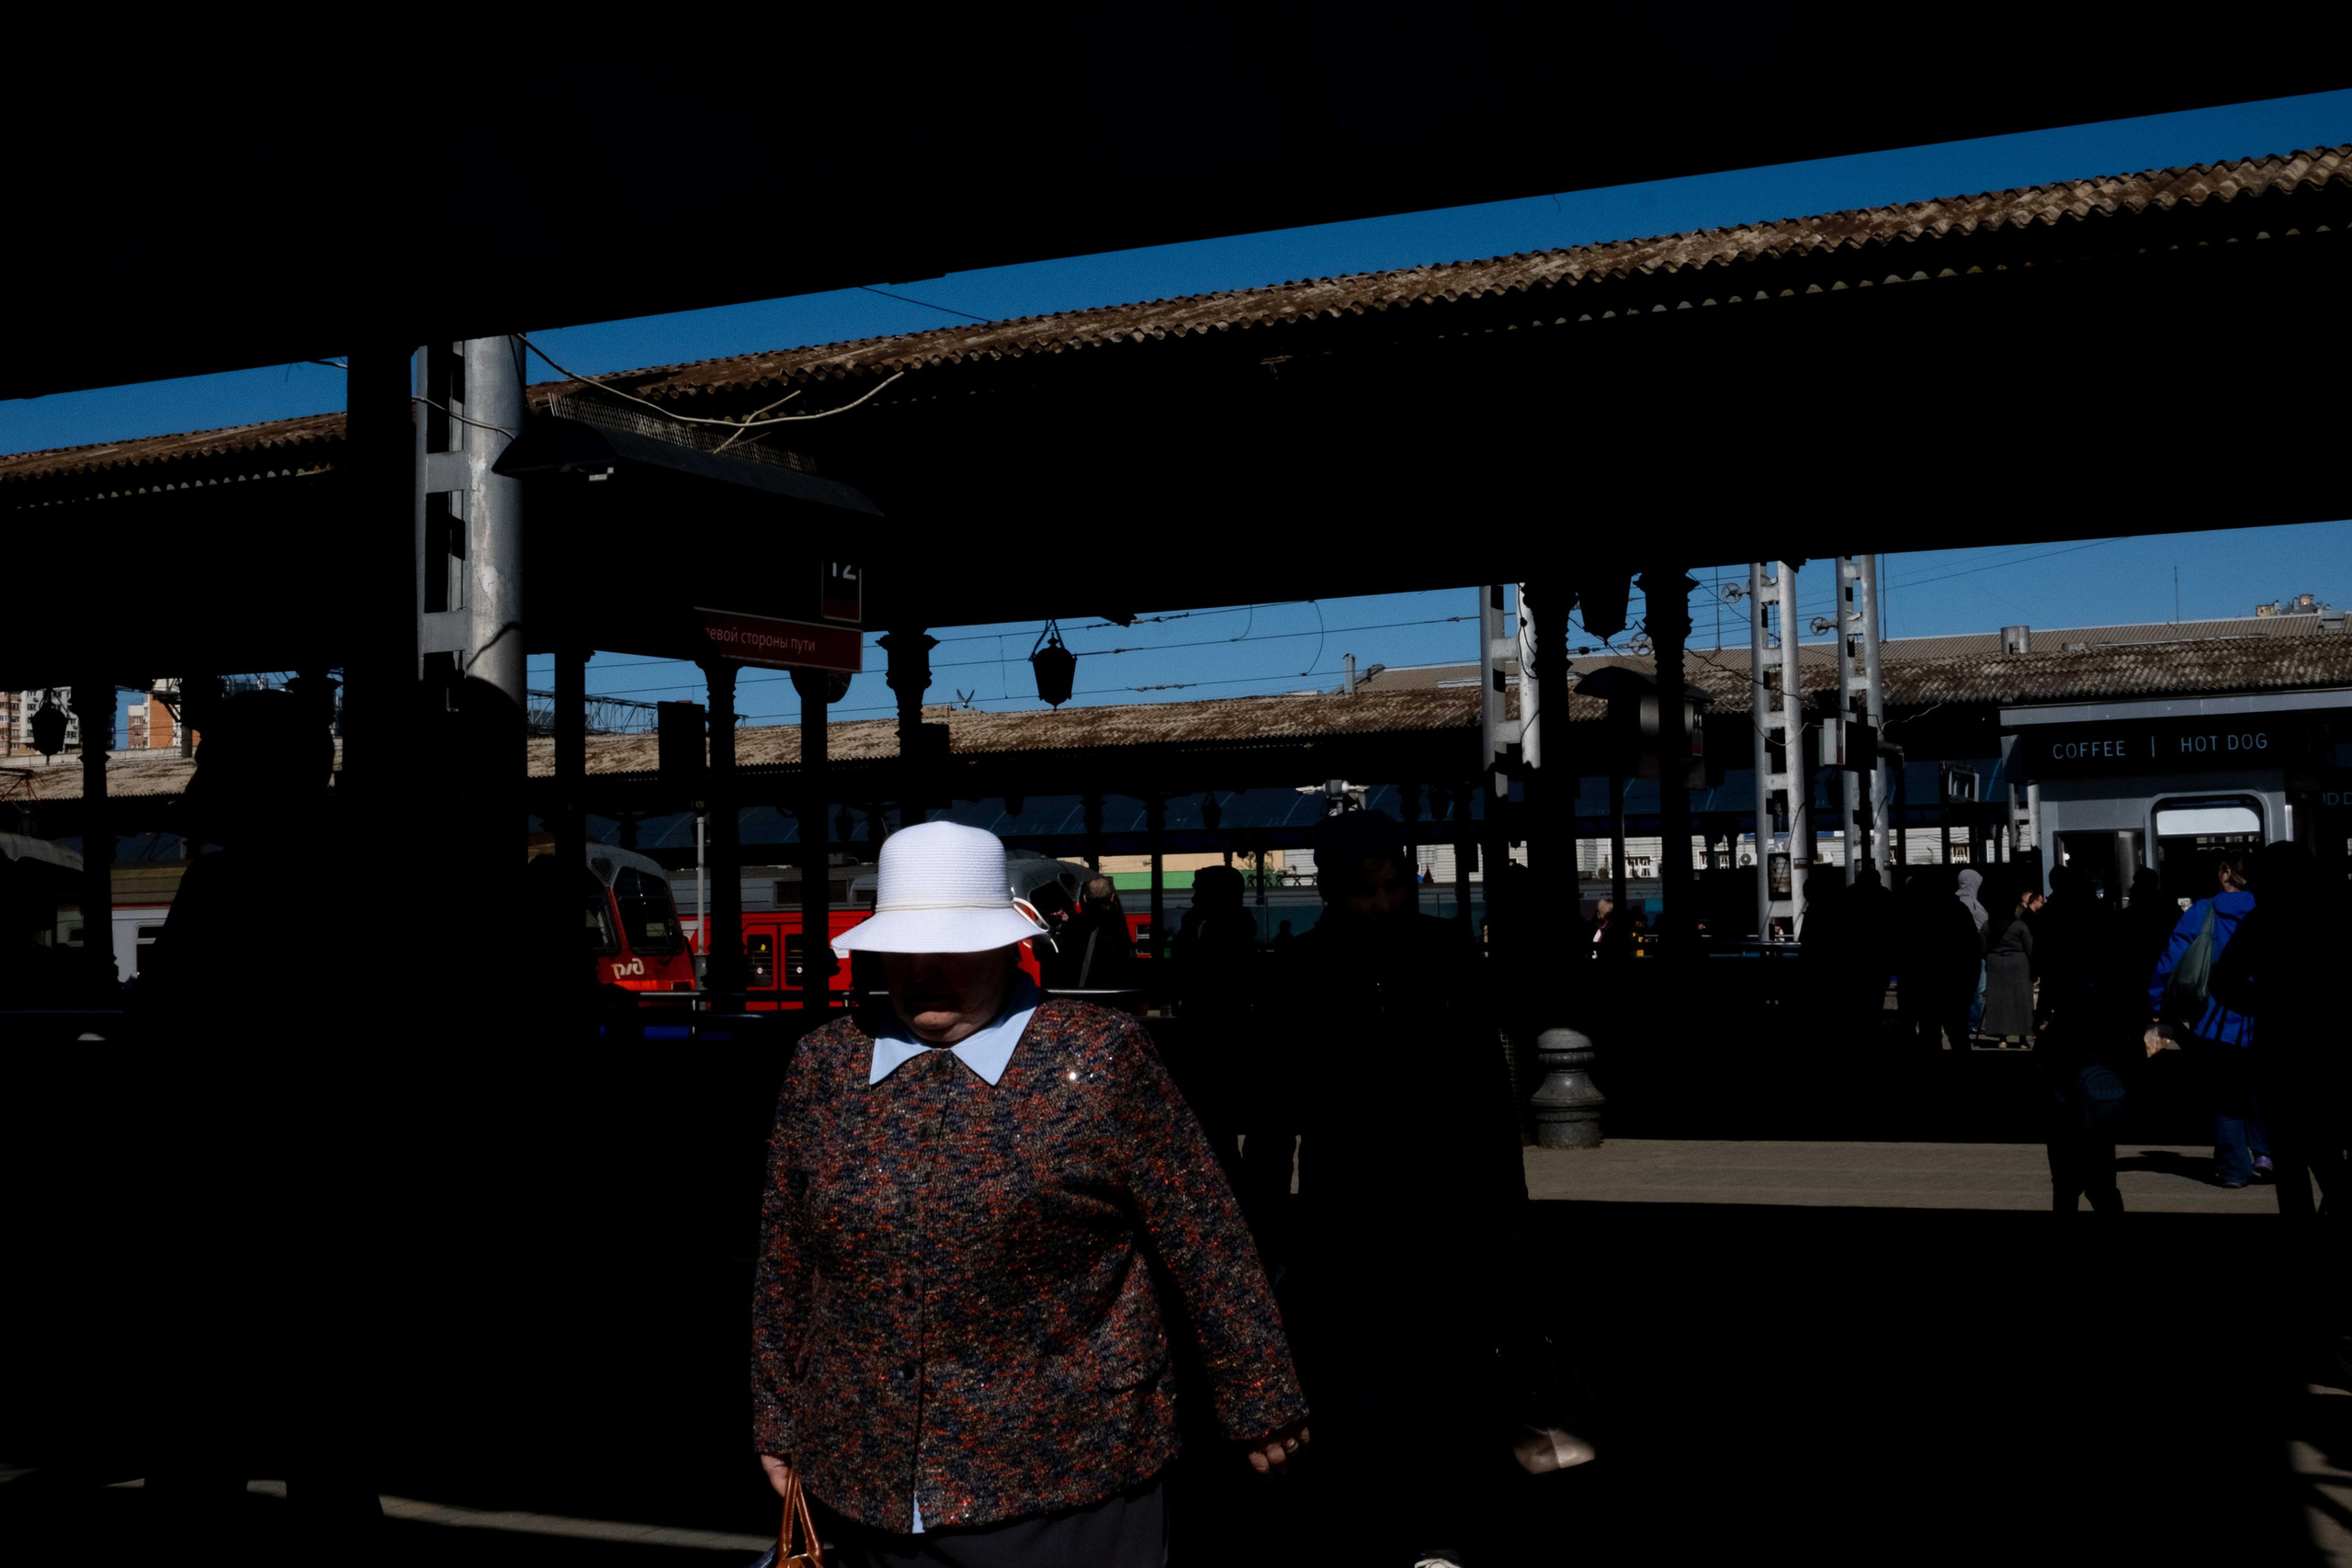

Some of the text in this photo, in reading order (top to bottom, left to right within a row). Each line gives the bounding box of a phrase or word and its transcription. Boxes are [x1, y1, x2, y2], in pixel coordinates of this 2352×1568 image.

[741, 631, 788, 649] стороны
[790, 637, 816, 655] пути
[2052, 732, 2268, 760] COFFEE HOT DOG
